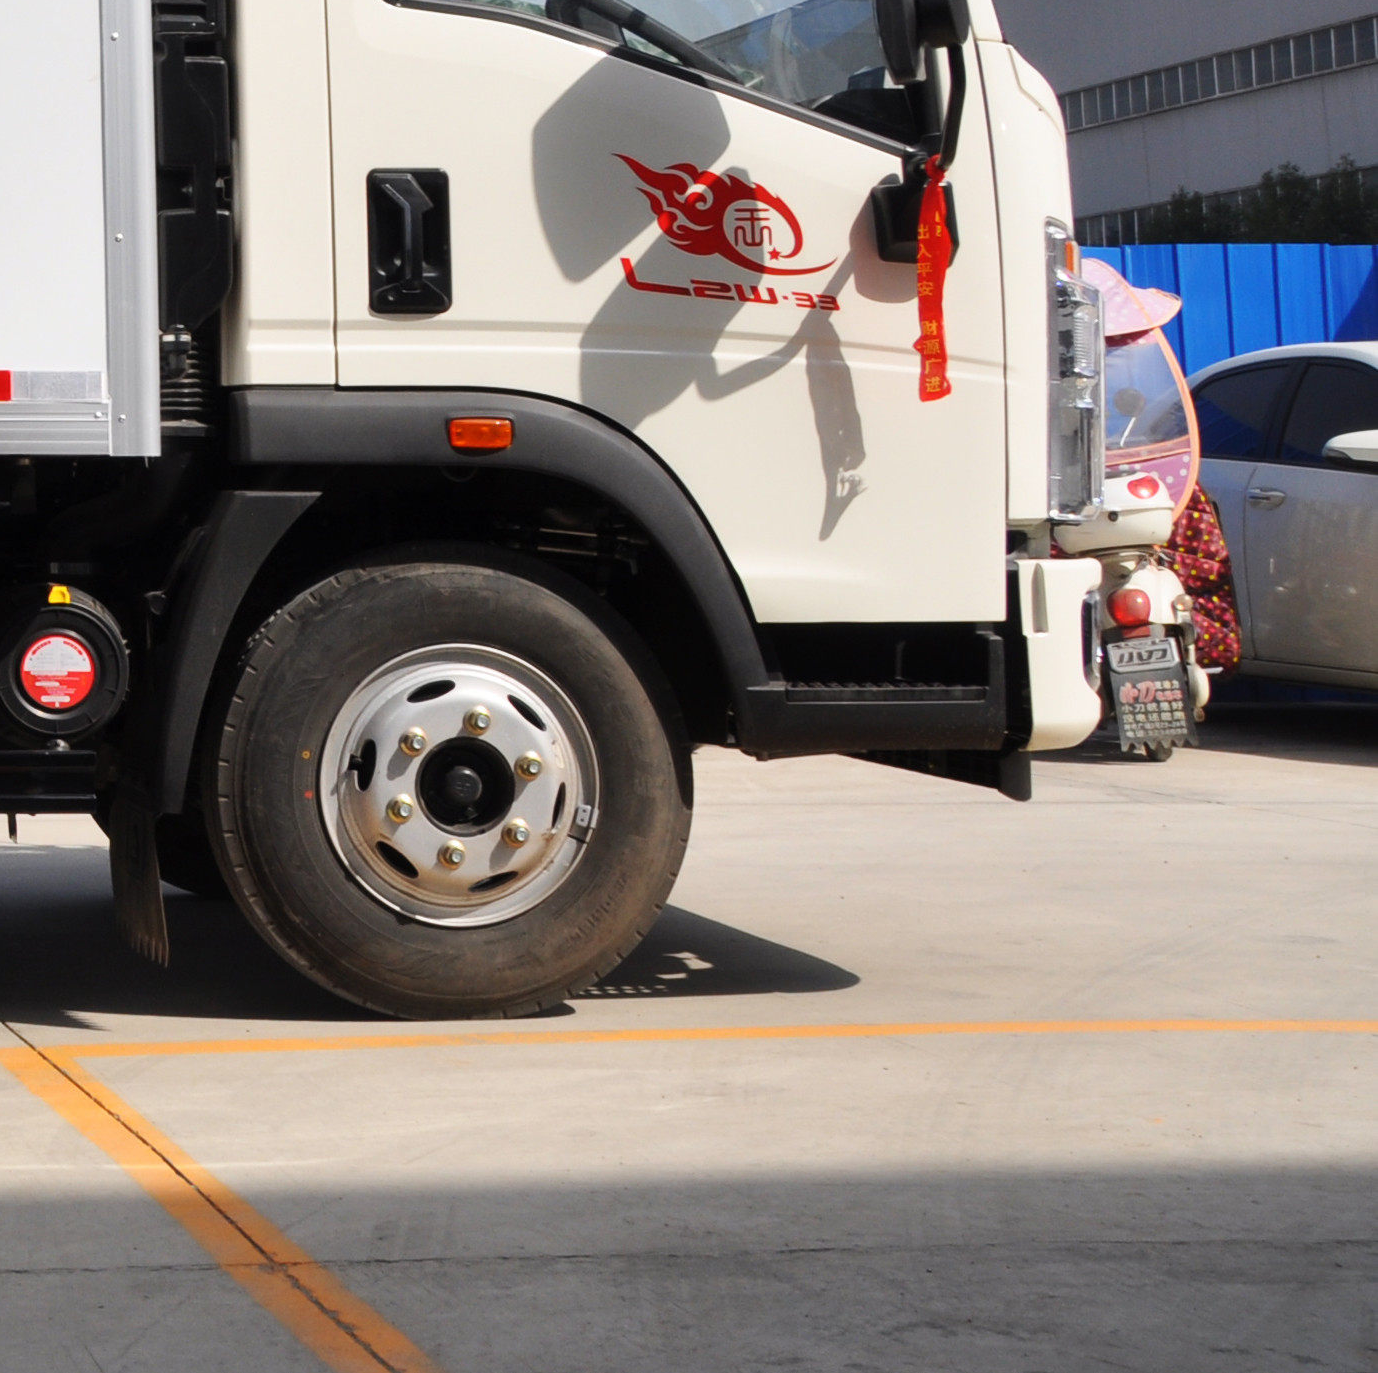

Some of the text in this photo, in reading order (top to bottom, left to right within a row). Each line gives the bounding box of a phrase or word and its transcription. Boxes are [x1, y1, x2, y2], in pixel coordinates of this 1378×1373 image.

[917, 223, 943, 393] 出入平安 财源广进
